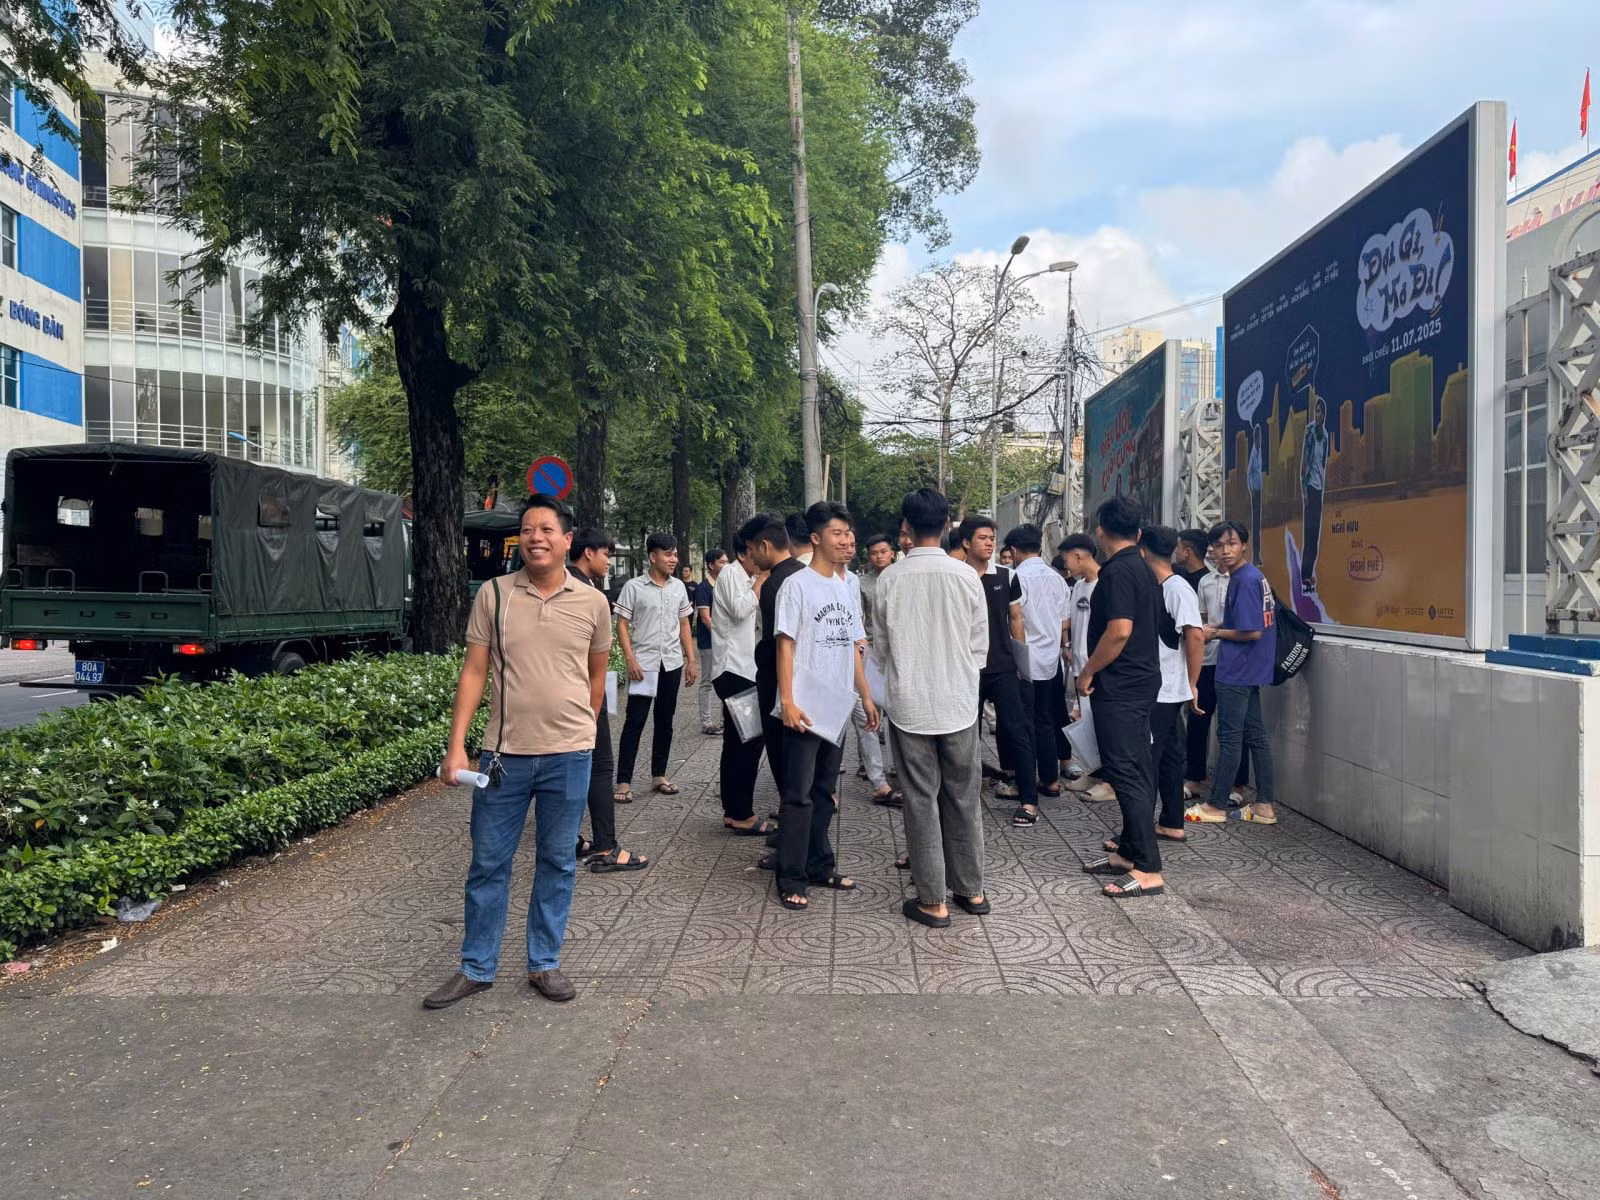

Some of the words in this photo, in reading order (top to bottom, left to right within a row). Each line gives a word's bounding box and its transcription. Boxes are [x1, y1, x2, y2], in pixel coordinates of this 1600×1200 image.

[9, 299, 41, 331] BÓNG
[43, 314, 64, 341] BÀN
[1391, 317, 1442, 353] 11.07.2025
[43, 609, 168, 620] FUSO
[81, 662, 97, 672] 80A
[1281, 641, 1304, 671] FASHION
